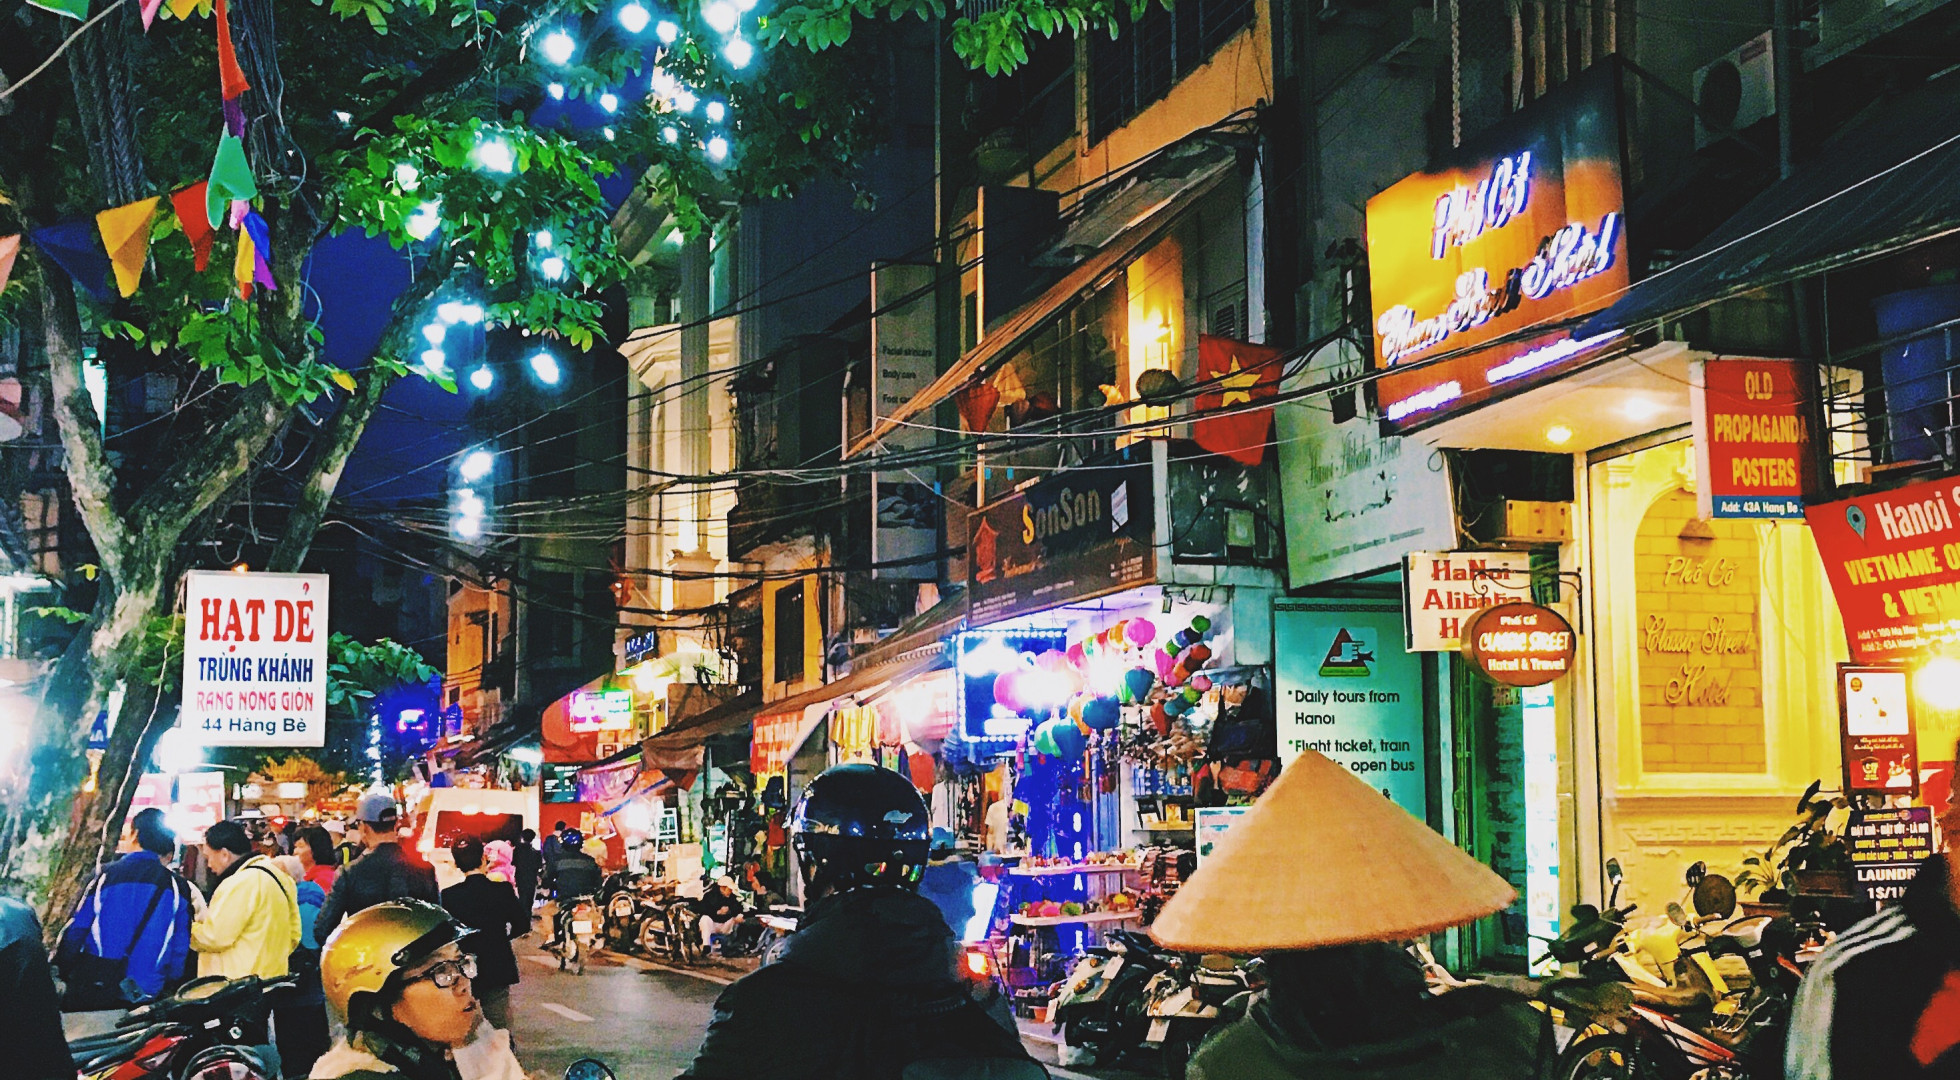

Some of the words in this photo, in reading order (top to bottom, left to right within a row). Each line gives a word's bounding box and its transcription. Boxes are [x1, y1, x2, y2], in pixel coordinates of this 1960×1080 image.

[1745, 371, 1773, 400] OLD
[1714, 414, 1810, 443] PROPAGANDA
[1732, 457, 1797, 487] POSTERS
[1022, 487, 1100, 545] SonSon
[1721, 501, 1741, 513] Add:
[1743, 501, 1760, 513] 43A
[1763, 502, 1785, 515] Hang
[1875, 491, 1952, 541] Hanoi
[1431, 559, 1510, 581] HaNoi
[1882, 592, 1900, 618] &
[200, 598, 265, 652] HẠT
[273, 582, 314, 643] DẺ
[1529, 631, 1570, 653] STREET
[199, 652, 252, 681] TRÙNG
[258, 653, 313, 682] KHÁNH
[1488, 658, 1518, 671] Hotel
[1521, 658, 1530, 670] &
[1530, 658, 1566, 671] Travel
[197, 691, 233, 711] RANG
[1295, 690, 1329, 704] Daily
[1333, 690, 1365, 703] tours
[1369, 690, 1400, 703] from
[202, 718, 222, 731] 44
[229, 717, 276, 736] Hàng
[283, 717, 307, 732] Bè
[1295, 712, 1335, 725] Hanoi
[1335, 739, 1376, 753] ticket,
[1380, 739, 1410, 752] train
[1351, 760, 1386, 774] open
[1391, 759, 1415, 772] bus
[1857, 868, 1920, 881] LAUNDR
